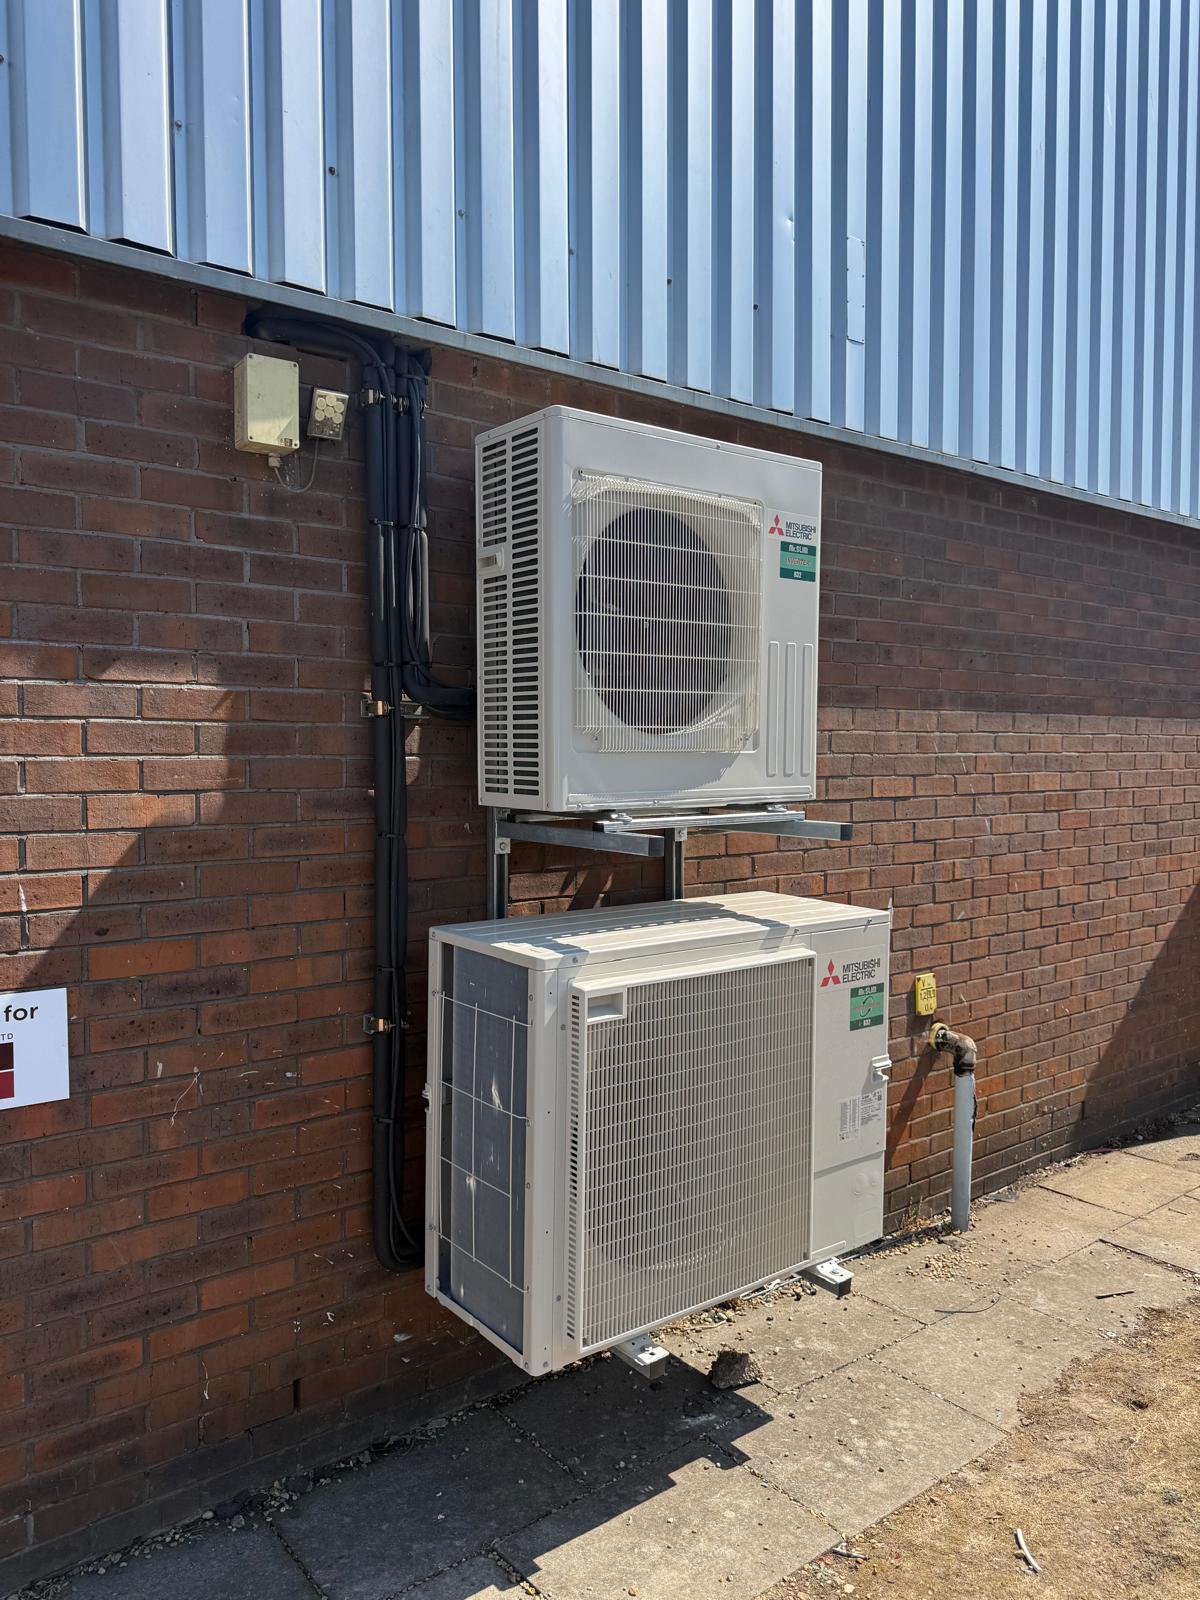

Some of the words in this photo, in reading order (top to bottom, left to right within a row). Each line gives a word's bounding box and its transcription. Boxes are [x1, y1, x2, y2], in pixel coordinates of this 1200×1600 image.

[785, 521, 816, 533] MITSUBISHI
[785, 530, 812, 540] ELECTRIC
[843, 958, 880, 973] MITSUBISHI
[843, 969, 876, 983] ELECTRIC
[4, 1005, 39, 1022] for
